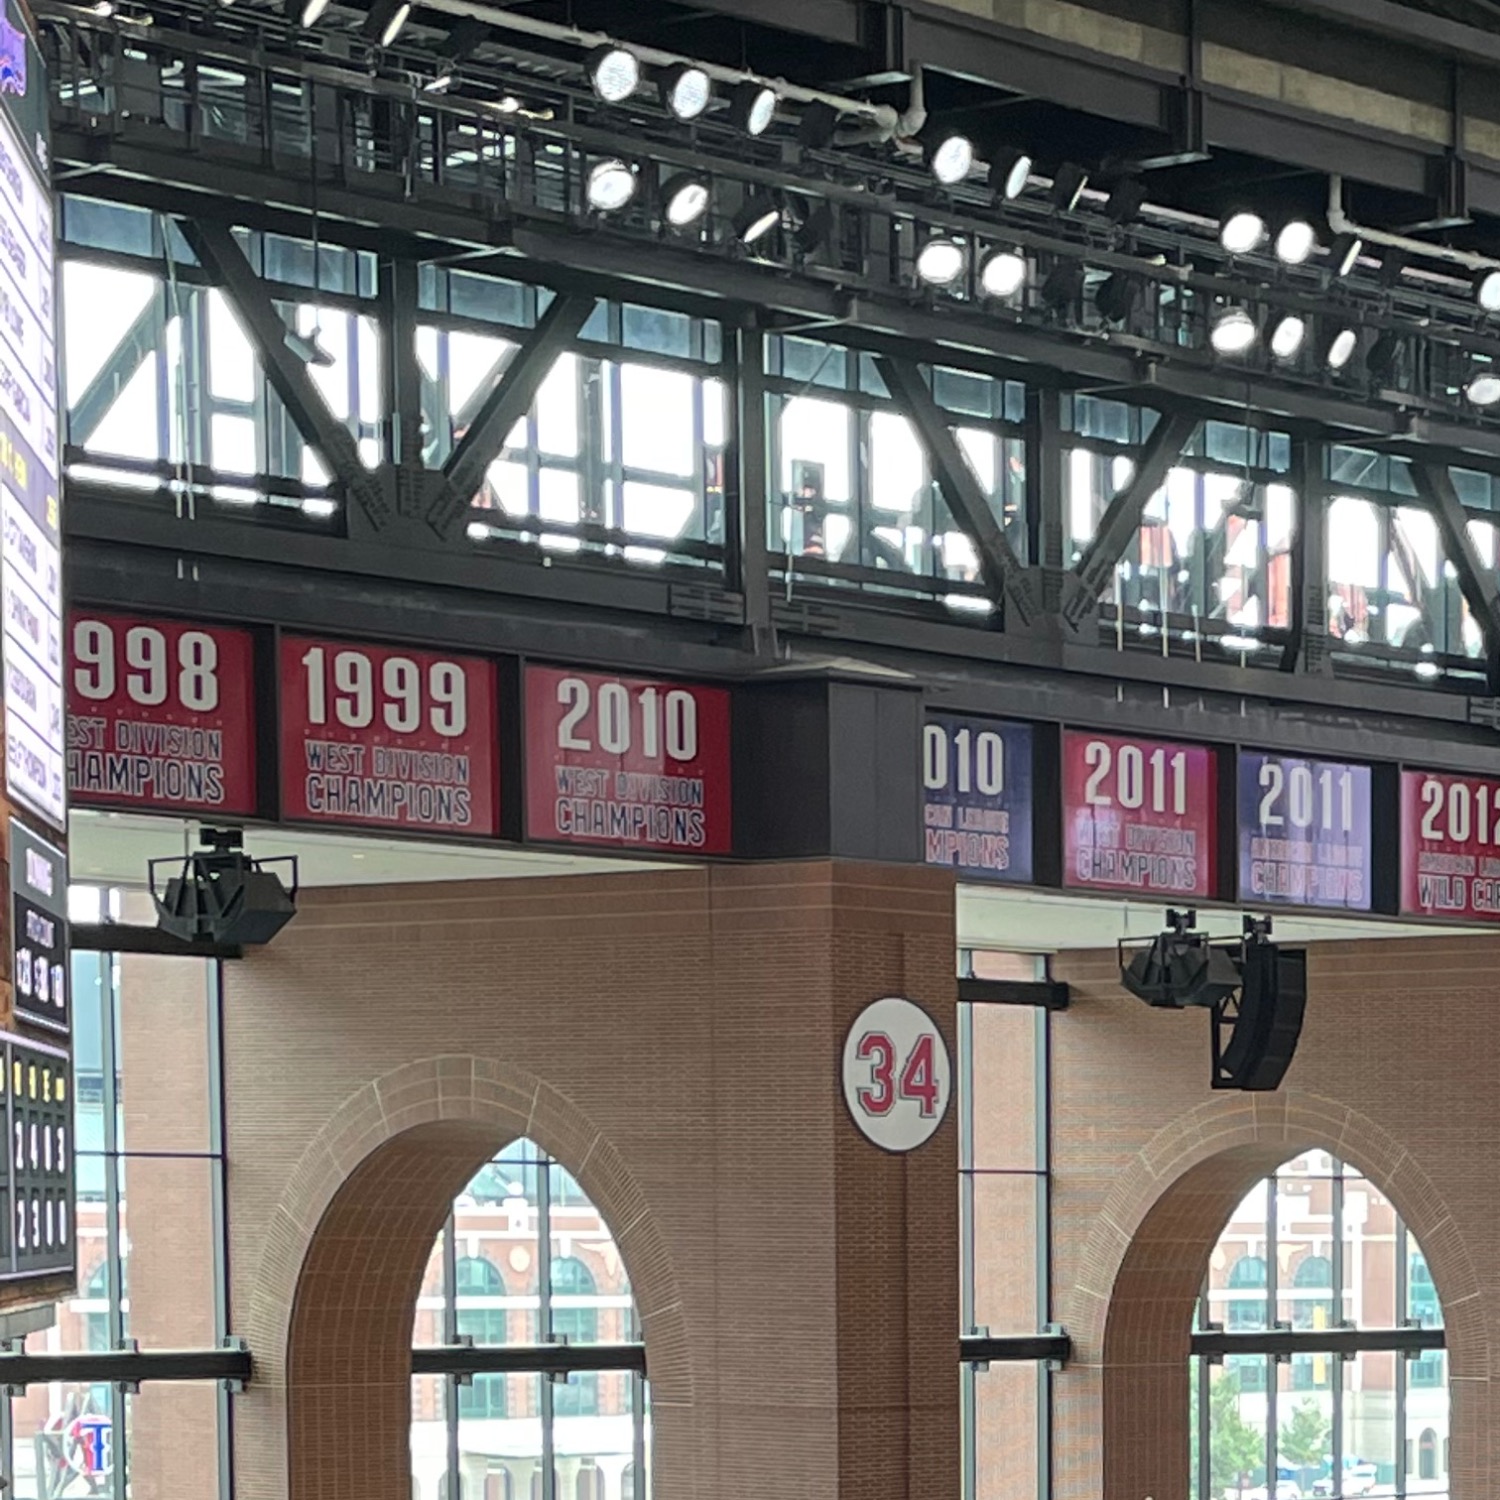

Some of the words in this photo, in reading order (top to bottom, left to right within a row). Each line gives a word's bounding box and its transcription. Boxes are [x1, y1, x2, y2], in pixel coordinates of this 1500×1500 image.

[74, 620, 218, 712] 998
[302, 647, 467, 737] 1999
[66, 714, 107, 749] EST
[115, 719, 223, 761] DIVISION
[557, 678, 697, 761] 2010
[66, 749, 225, 804] HAMPIONS
[304, 739, 365, 775] WEST
[373, 746, 469, 786] DIVISION
[555, 765, 609, 799] WEST
[615, 770, 704, 808] DIVISION
[923, 724, 1003, 795] 010
[1085, 741, 1186, 814] 2011
[306, 773, 471, 826] CHAMPIONS
[555, 797, 706, 847] CHAMPIONS
[1259, 763, 1353, 832] 2011
[925, 828, 1010, 871] MPIONS
[1076, 845, 1197, 891] CHAMPIONS
[1418, 873, 1467, 910] WILD
[856, 1031, 939, 1118] 34
